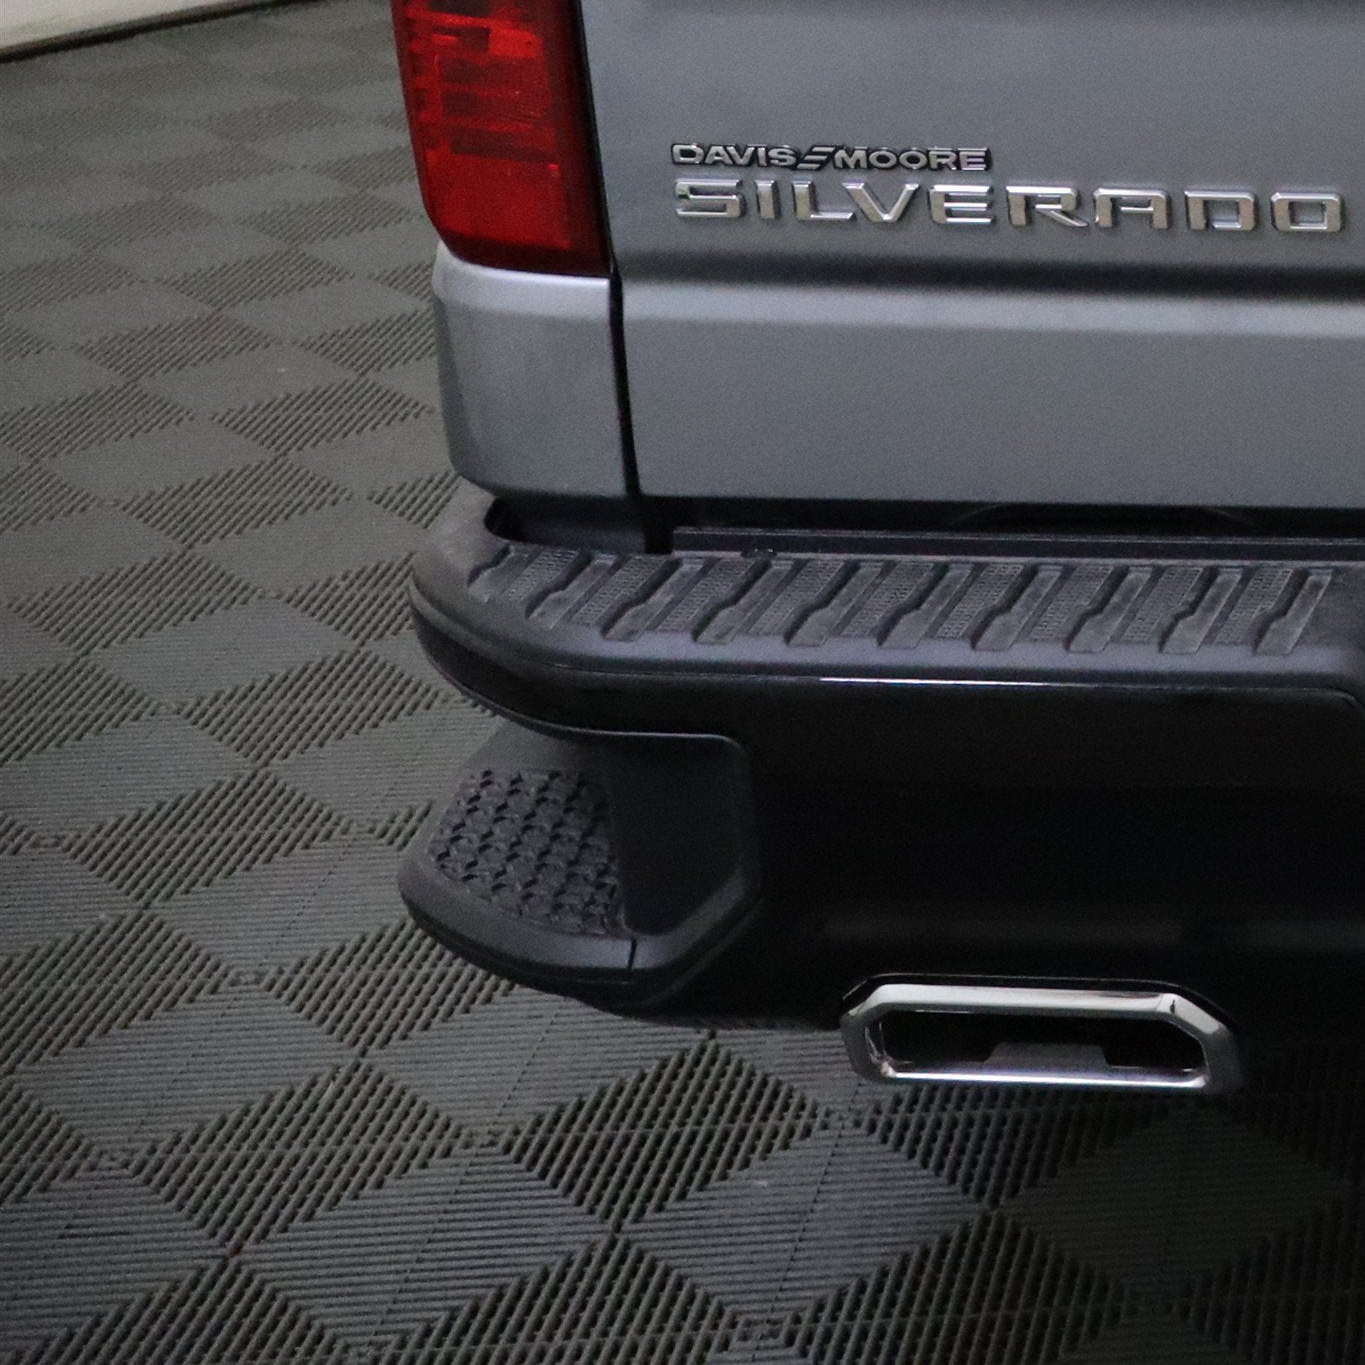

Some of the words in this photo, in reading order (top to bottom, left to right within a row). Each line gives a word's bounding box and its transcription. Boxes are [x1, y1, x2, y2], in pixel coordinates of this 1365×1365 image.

[672, 142, 798, 166] DAVIS
[833, 146, 989, 171] MOORE
[674, 178, 1345, 233] SILVERADO
